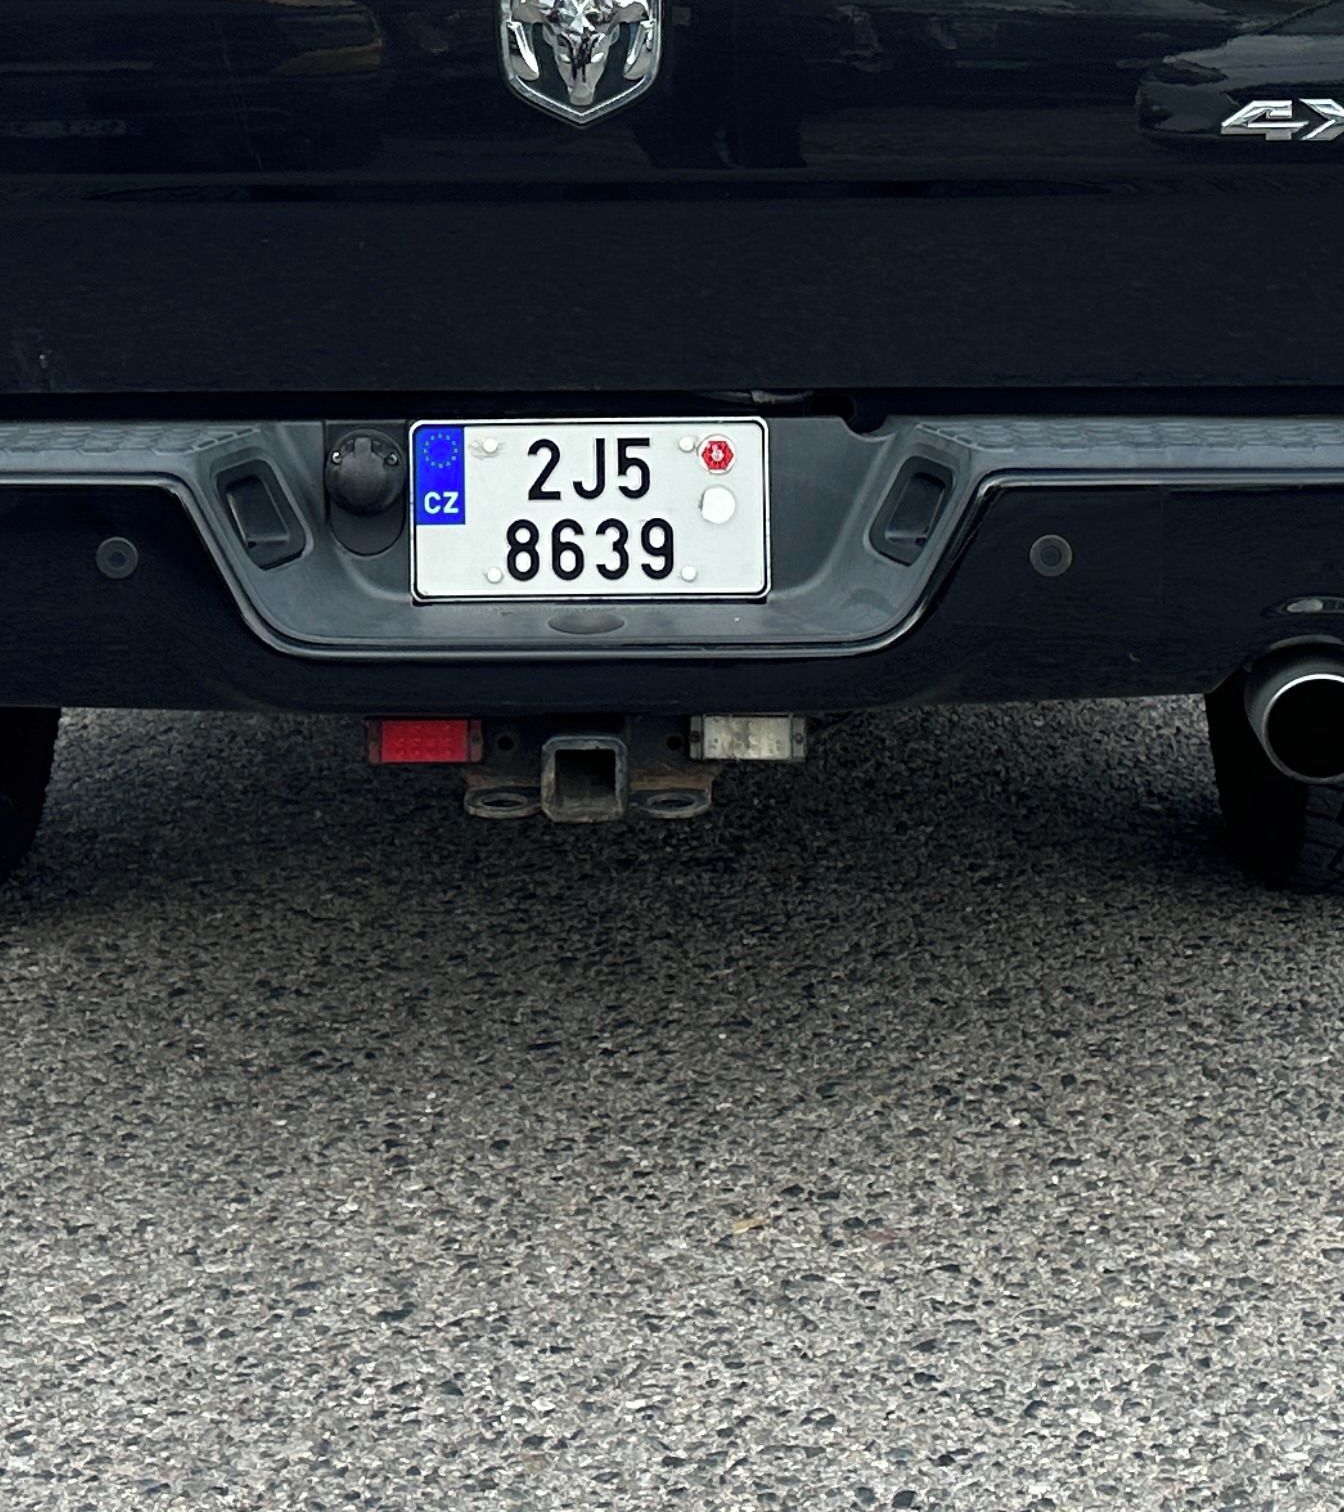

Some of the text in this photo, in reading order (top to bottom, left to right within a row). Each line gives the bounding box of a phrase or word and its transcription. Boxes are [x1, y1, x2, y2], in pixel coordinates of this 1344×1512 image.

[526, 437, 653, 501] 2J5
[423, 491, 460, 515] CZ
[506, 518, 675, 581] 8639
